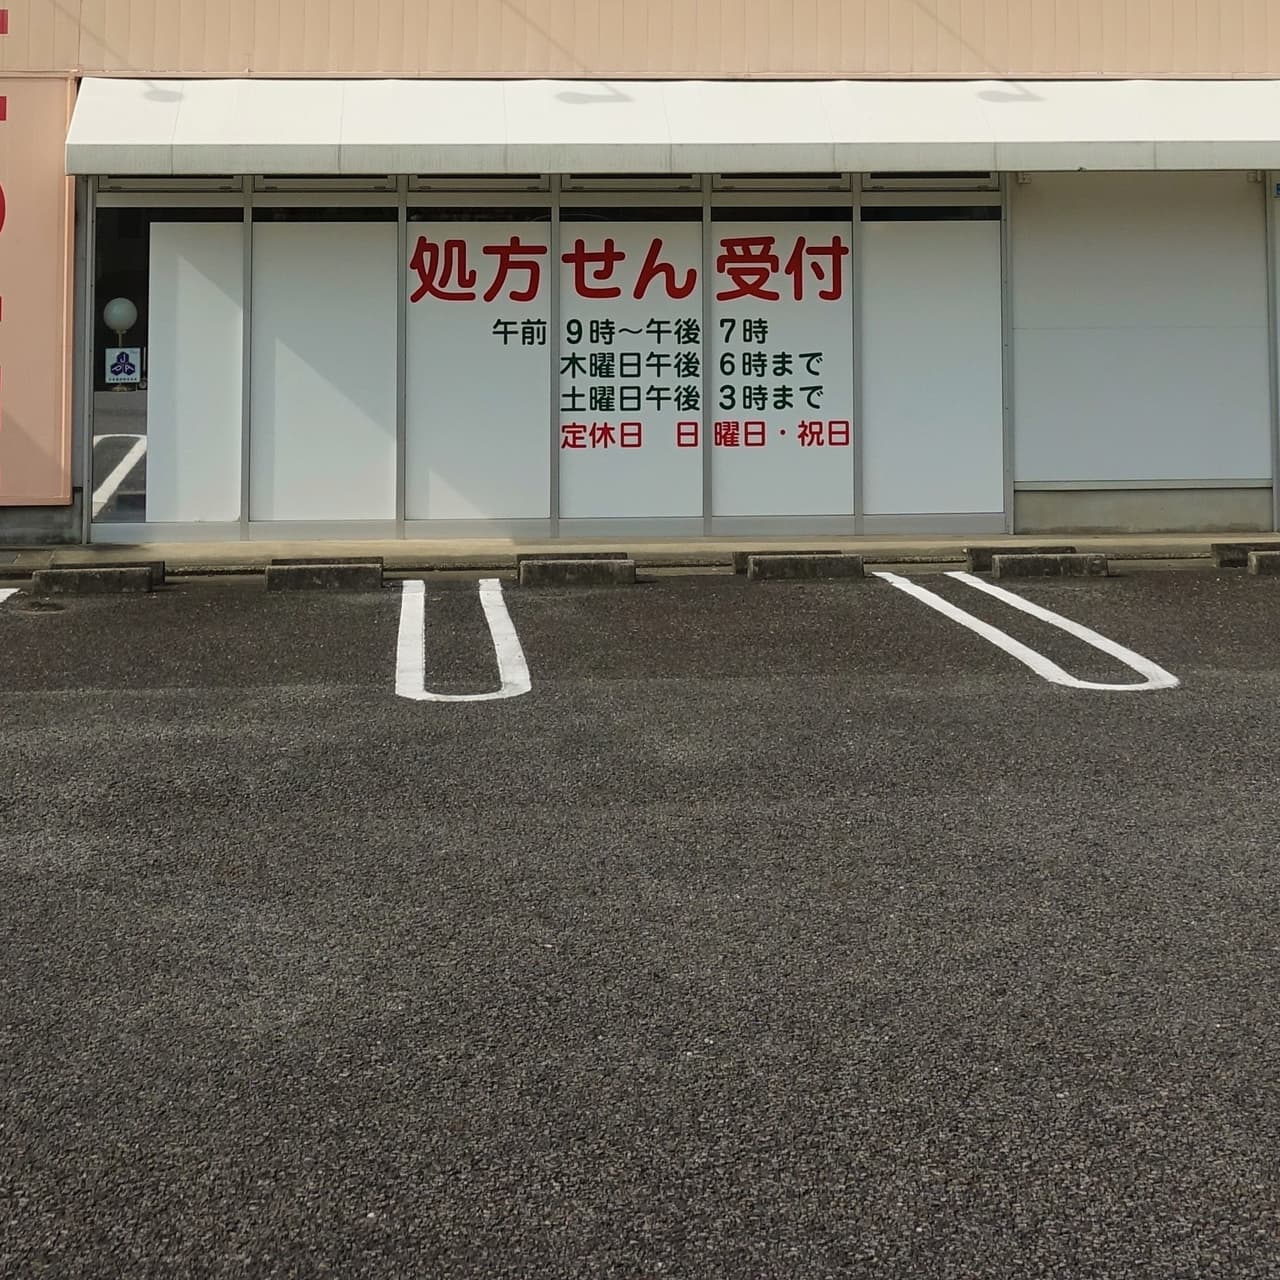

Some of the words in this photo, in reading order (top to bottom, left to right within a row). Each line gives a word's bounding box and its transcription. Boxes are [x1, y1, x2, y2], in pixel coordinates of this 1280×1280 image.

[410, 235, 850, 302] 処方せん受付
[561, 422, 642, 449] 定休日
